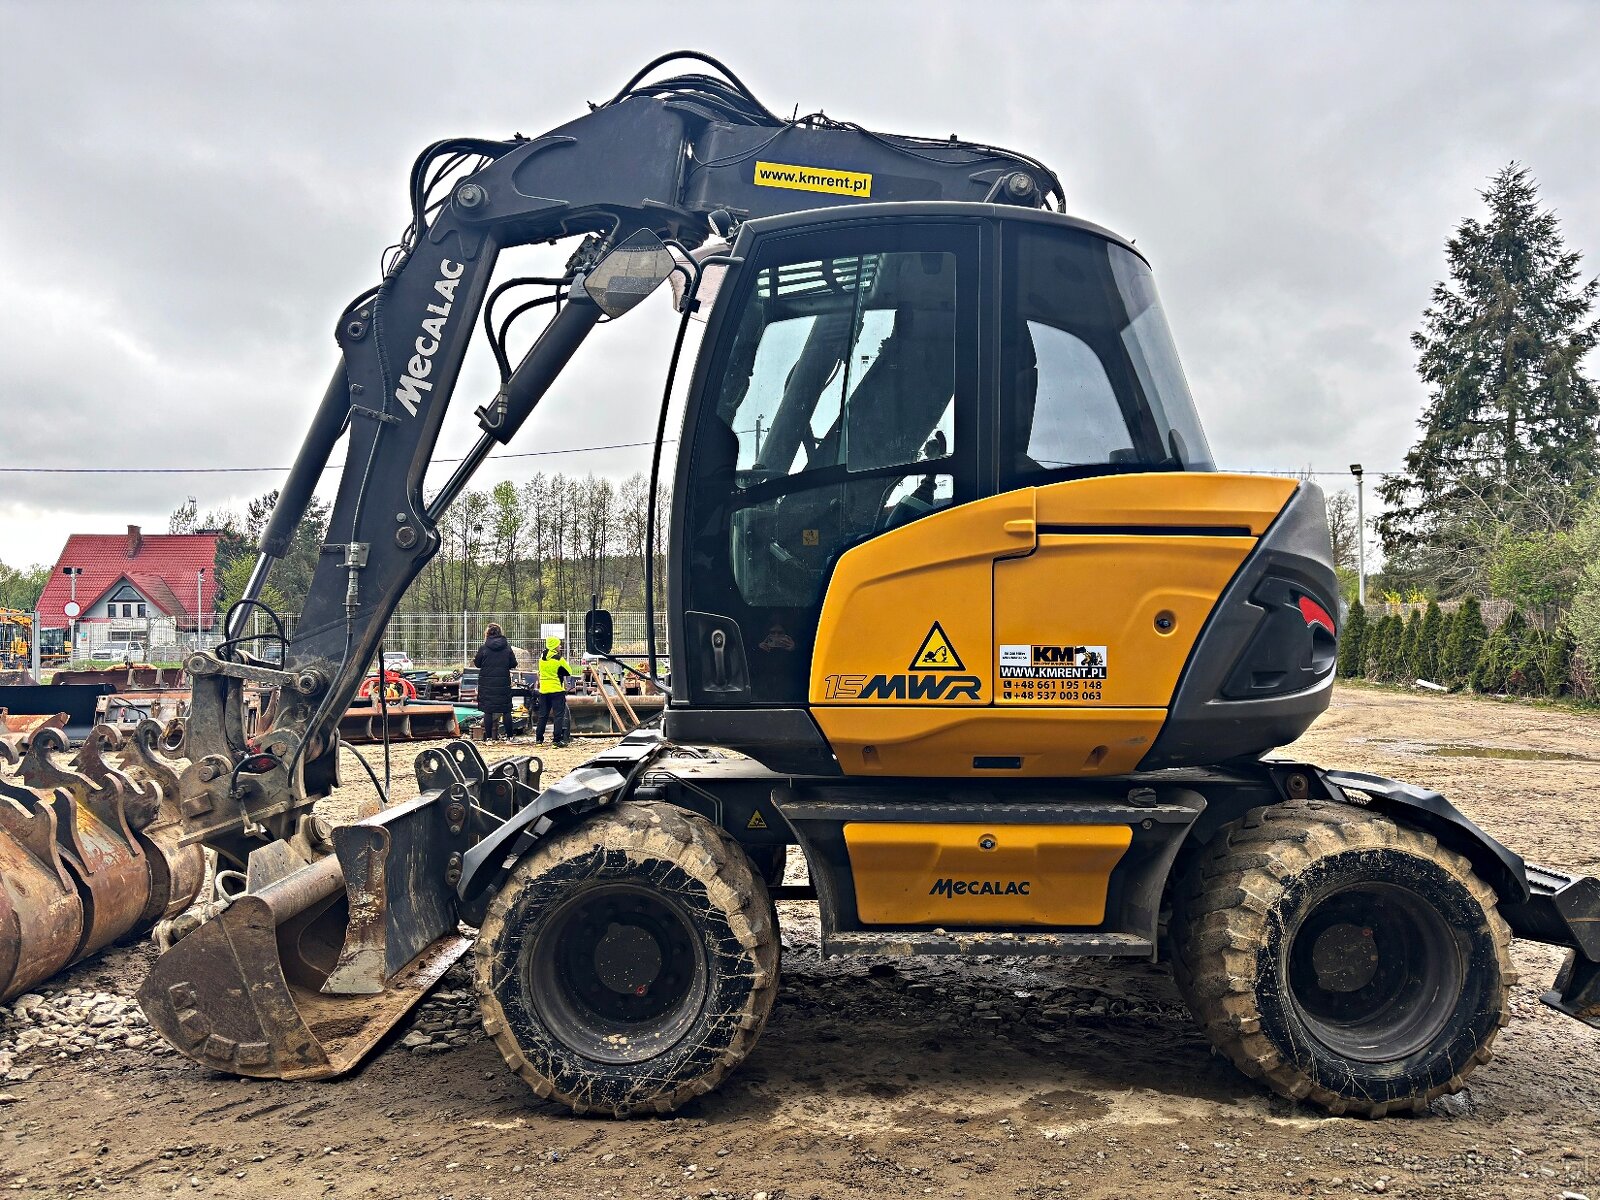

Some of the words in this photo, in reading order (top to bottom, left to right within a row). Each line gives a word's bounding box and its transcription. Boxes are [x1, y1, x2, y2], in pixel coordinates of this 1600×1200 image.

[760, 169, 867, 192] www.kmrent.pl
[1033, 646, 1074, 662] KM
[1001, 667, 1105, 678] WWW.KMRENT.PL
[1014, 681, 1034, 689] +48
[1037, 681, 1056, 689] 661
[1061, 681, 1079, 689] 195
[1083, 681, 1102, 689] 148
[1014, 692, 1034, 700] +48
[1037, 692, 1056, 700] 537
[1060, 692, 1079, 700] 003
[1082, 692, 1102, 700] 063
